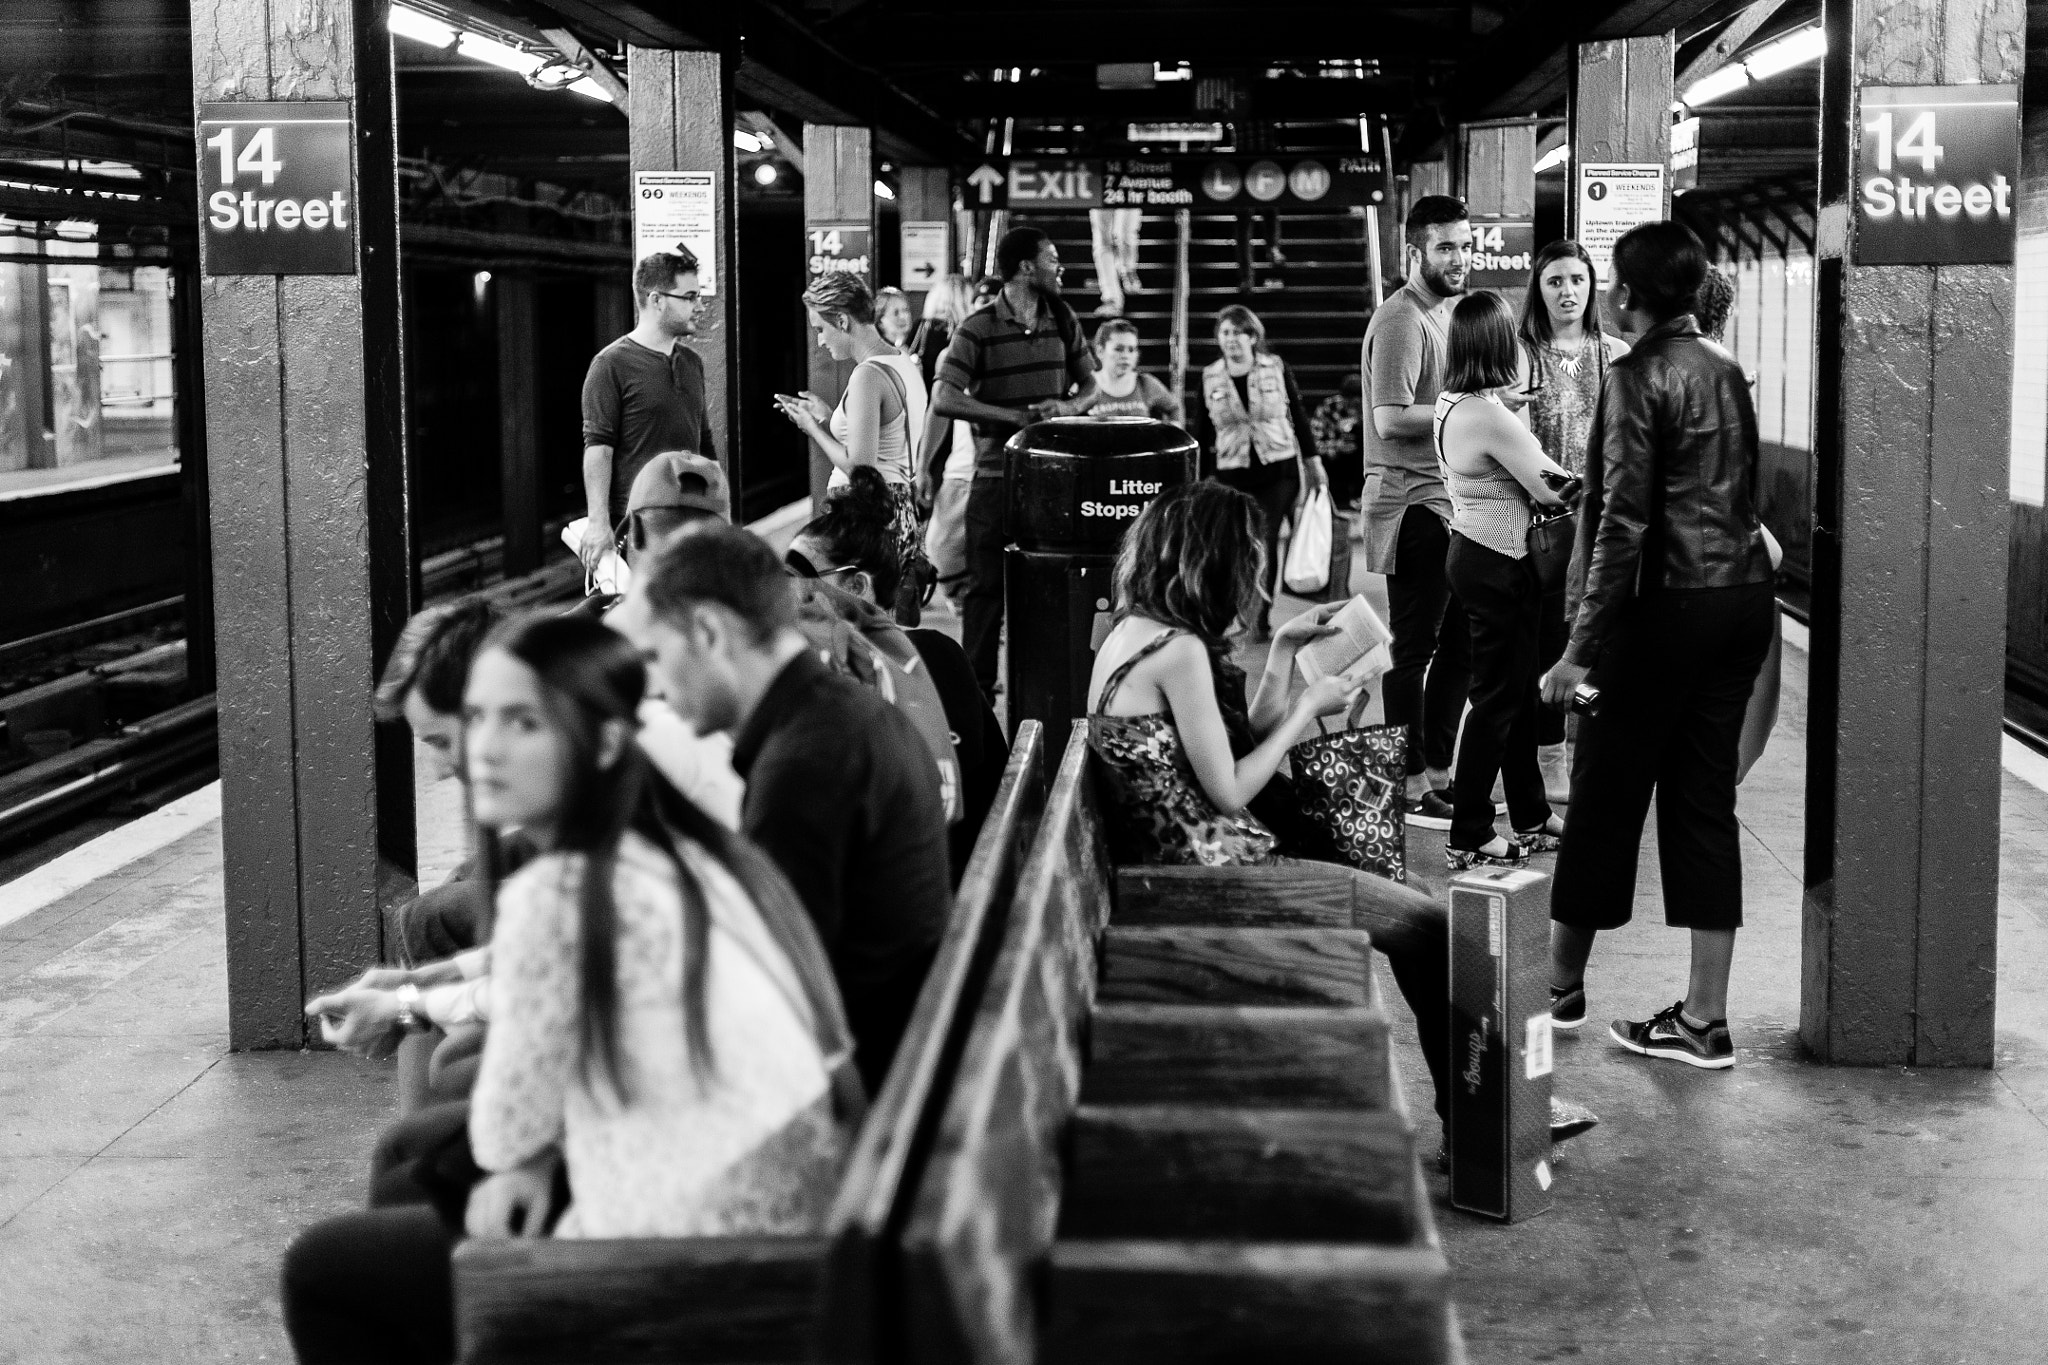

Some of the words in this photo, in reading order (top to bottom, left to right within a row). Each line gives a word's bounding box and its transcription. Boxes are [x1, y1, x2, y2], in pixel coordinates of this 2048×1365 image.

[1865, 111, 1944, 170] 14
[206, 126, 282, 184] 14
[1127, 160, 1173, 174] Street
[1009, 161, 1093, 199] Exit
[1104, 174, 1117, 188] 7
[1118, 175, 1174, 189] Avenue
[1213, 168, 1234, 194] L
[1257, 169, 1275, 193] F
[1297, 168, 1325, 193] M
[1103, 188, 1126, 204] 24
[1128, 188, 1145, 204] hr
[1147, 188, 1193, 204] booth
[1863, 176, 2011, 217] Street
[209, 190, 348, 231] Street
[809, 230, 843, 255] 14
[1472, 226, 1505, 252] 14
[809, 255, 870, 274] Street
[1472, 252, 1531, 270] Street
[1110, 480, 1163, 495] Litter
[1080, 501, 1140, 520] Stops
[1463, 1032, 1488, 1085] Bouqs
